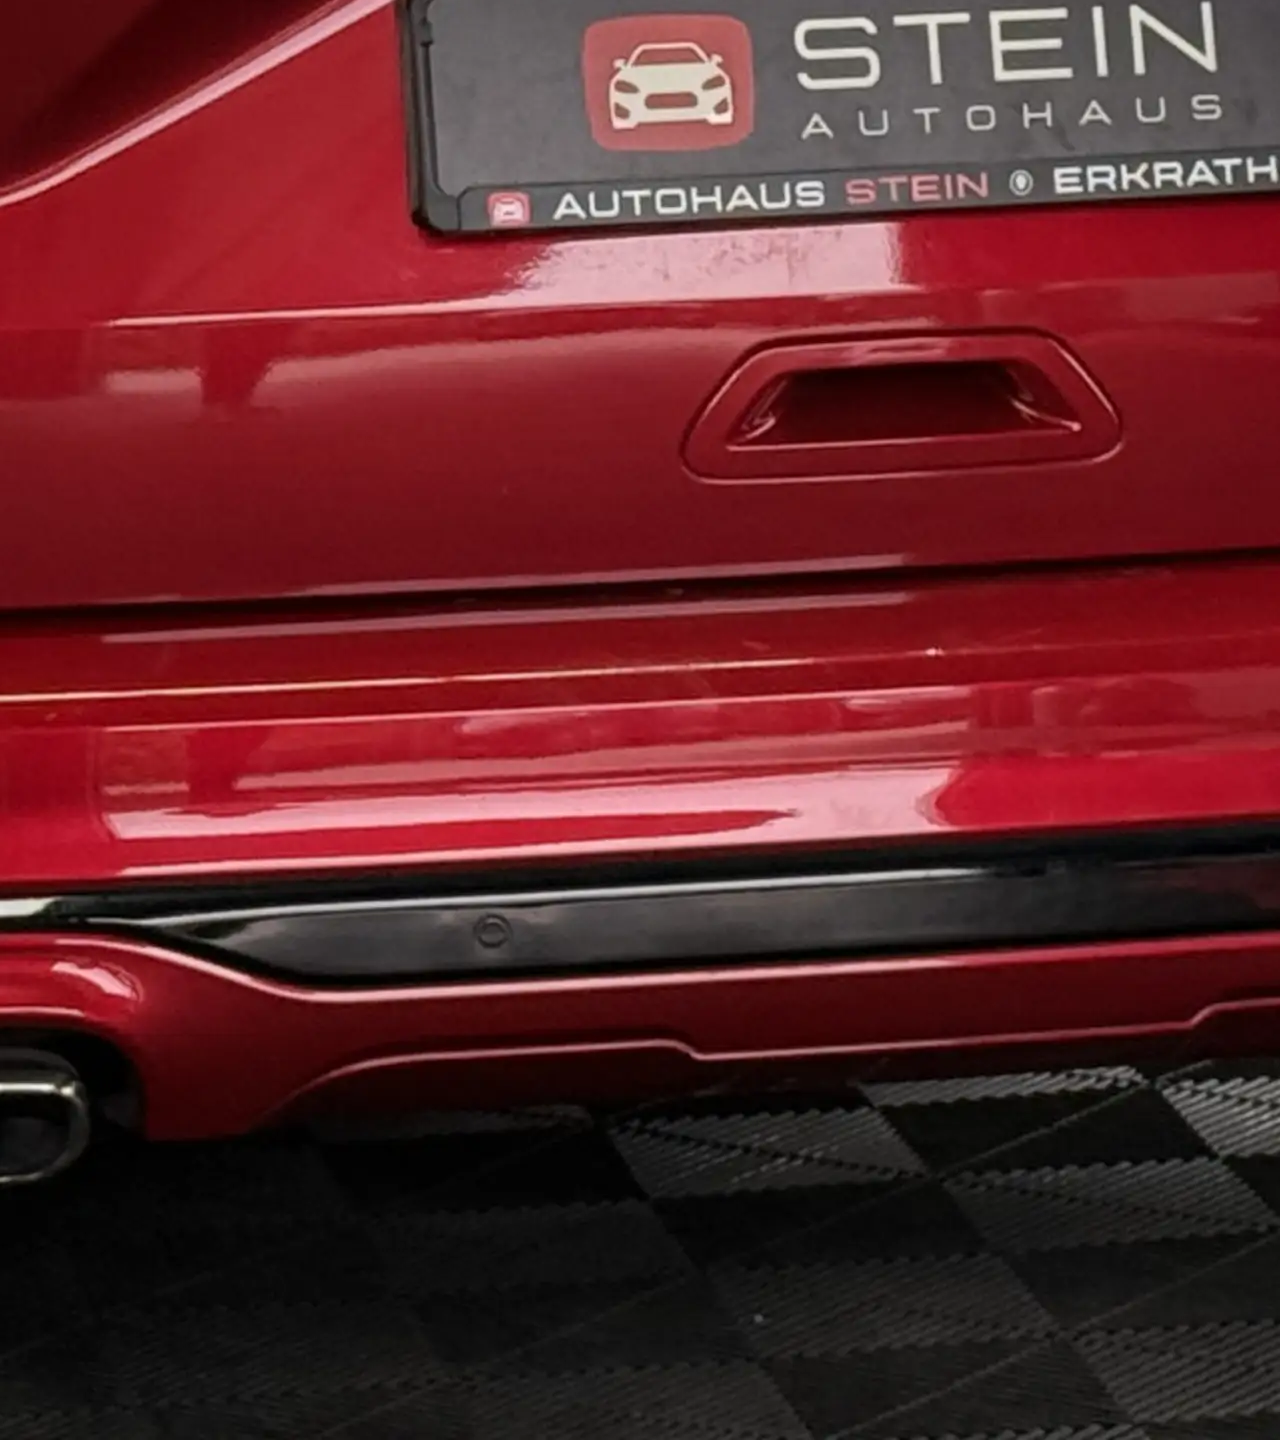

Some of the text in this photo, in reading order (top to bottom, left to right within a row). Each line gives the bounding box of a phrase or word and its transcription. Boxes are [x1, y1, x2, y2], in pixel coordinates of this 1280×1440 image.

[793, 0, 1218, 91] STEIN
[800, 93, 1223, 140] AUTOHAUS
[552, 154, 1280, 221] AUTOHAUS STEIN ERKRATH
